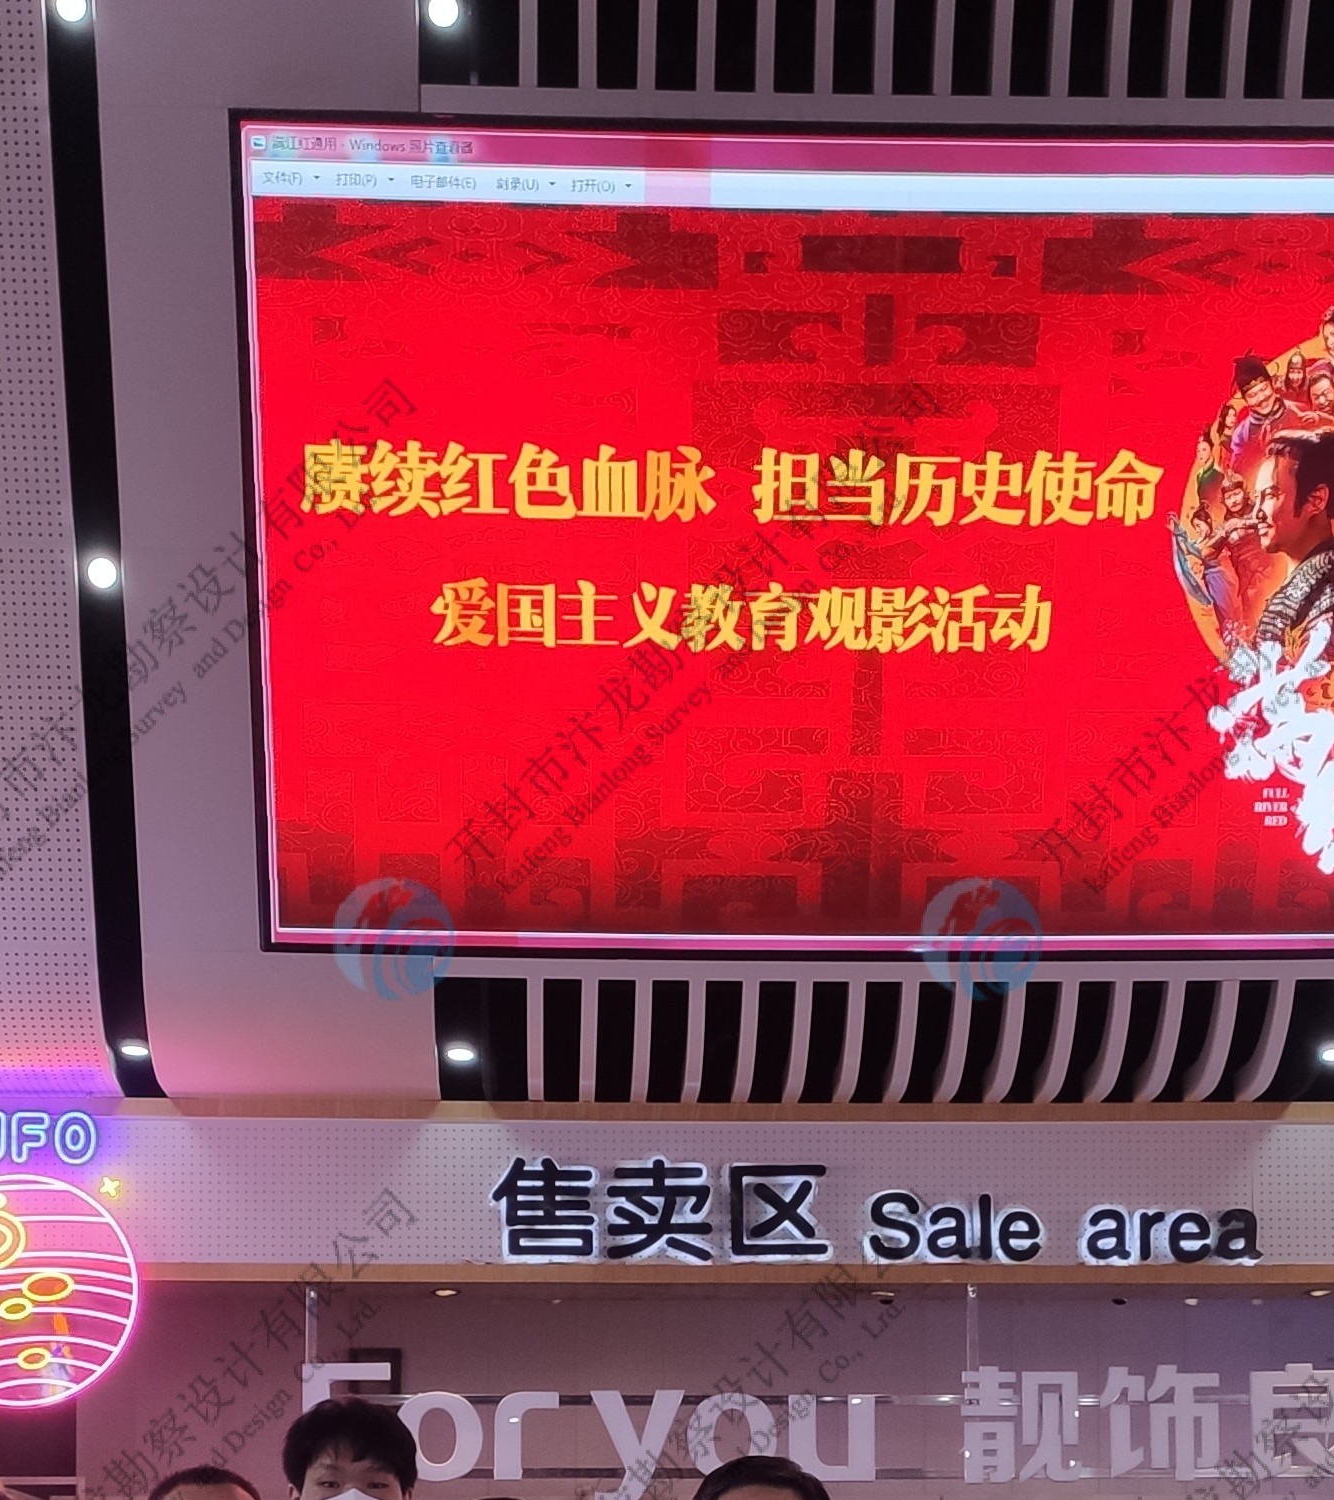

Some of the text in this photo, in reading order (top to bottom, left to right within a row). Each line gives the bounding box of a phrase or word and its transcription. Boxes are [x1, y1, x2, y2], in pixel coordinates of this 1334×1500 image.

[349, 139, 406, 154] Windows
[301, 438, 1165, 528] 赓续红色血脉 担当历史使命
[430, 578, 1053, 652] 爱国主义教育观影活动
[492, 1156, 1263, 1264] 售卖区 Sale area
